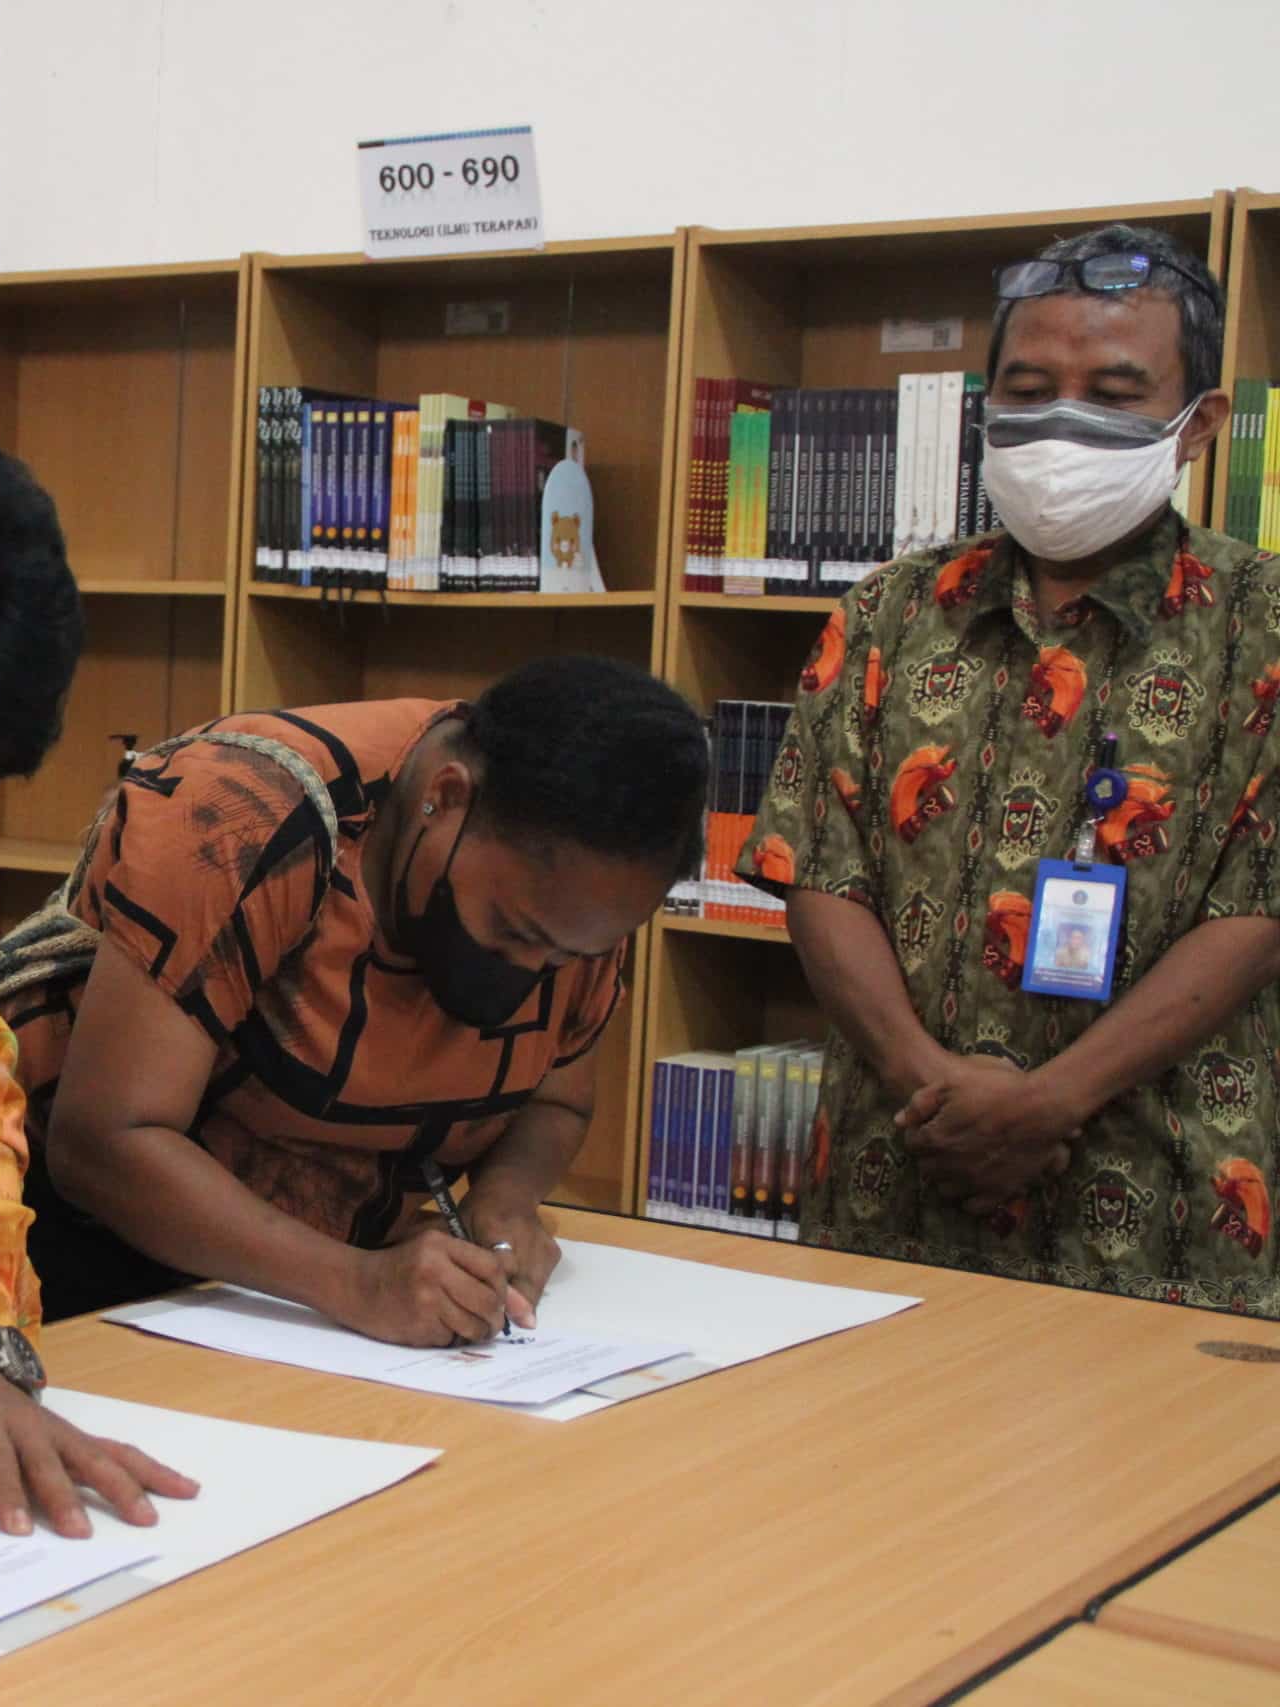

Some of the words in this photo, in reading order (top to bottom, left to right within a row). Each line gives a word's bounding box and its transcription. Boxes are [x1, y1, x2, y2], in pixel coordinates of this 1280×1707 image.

[379, 162, 435, 193] 600
[462, 154, 519, 189] 690
[369, 224, 435, 241] TEKNOLOGI
[437, 222, 469, 238] (ILMU
[474, 217, 538, 234] TERAPAN)
